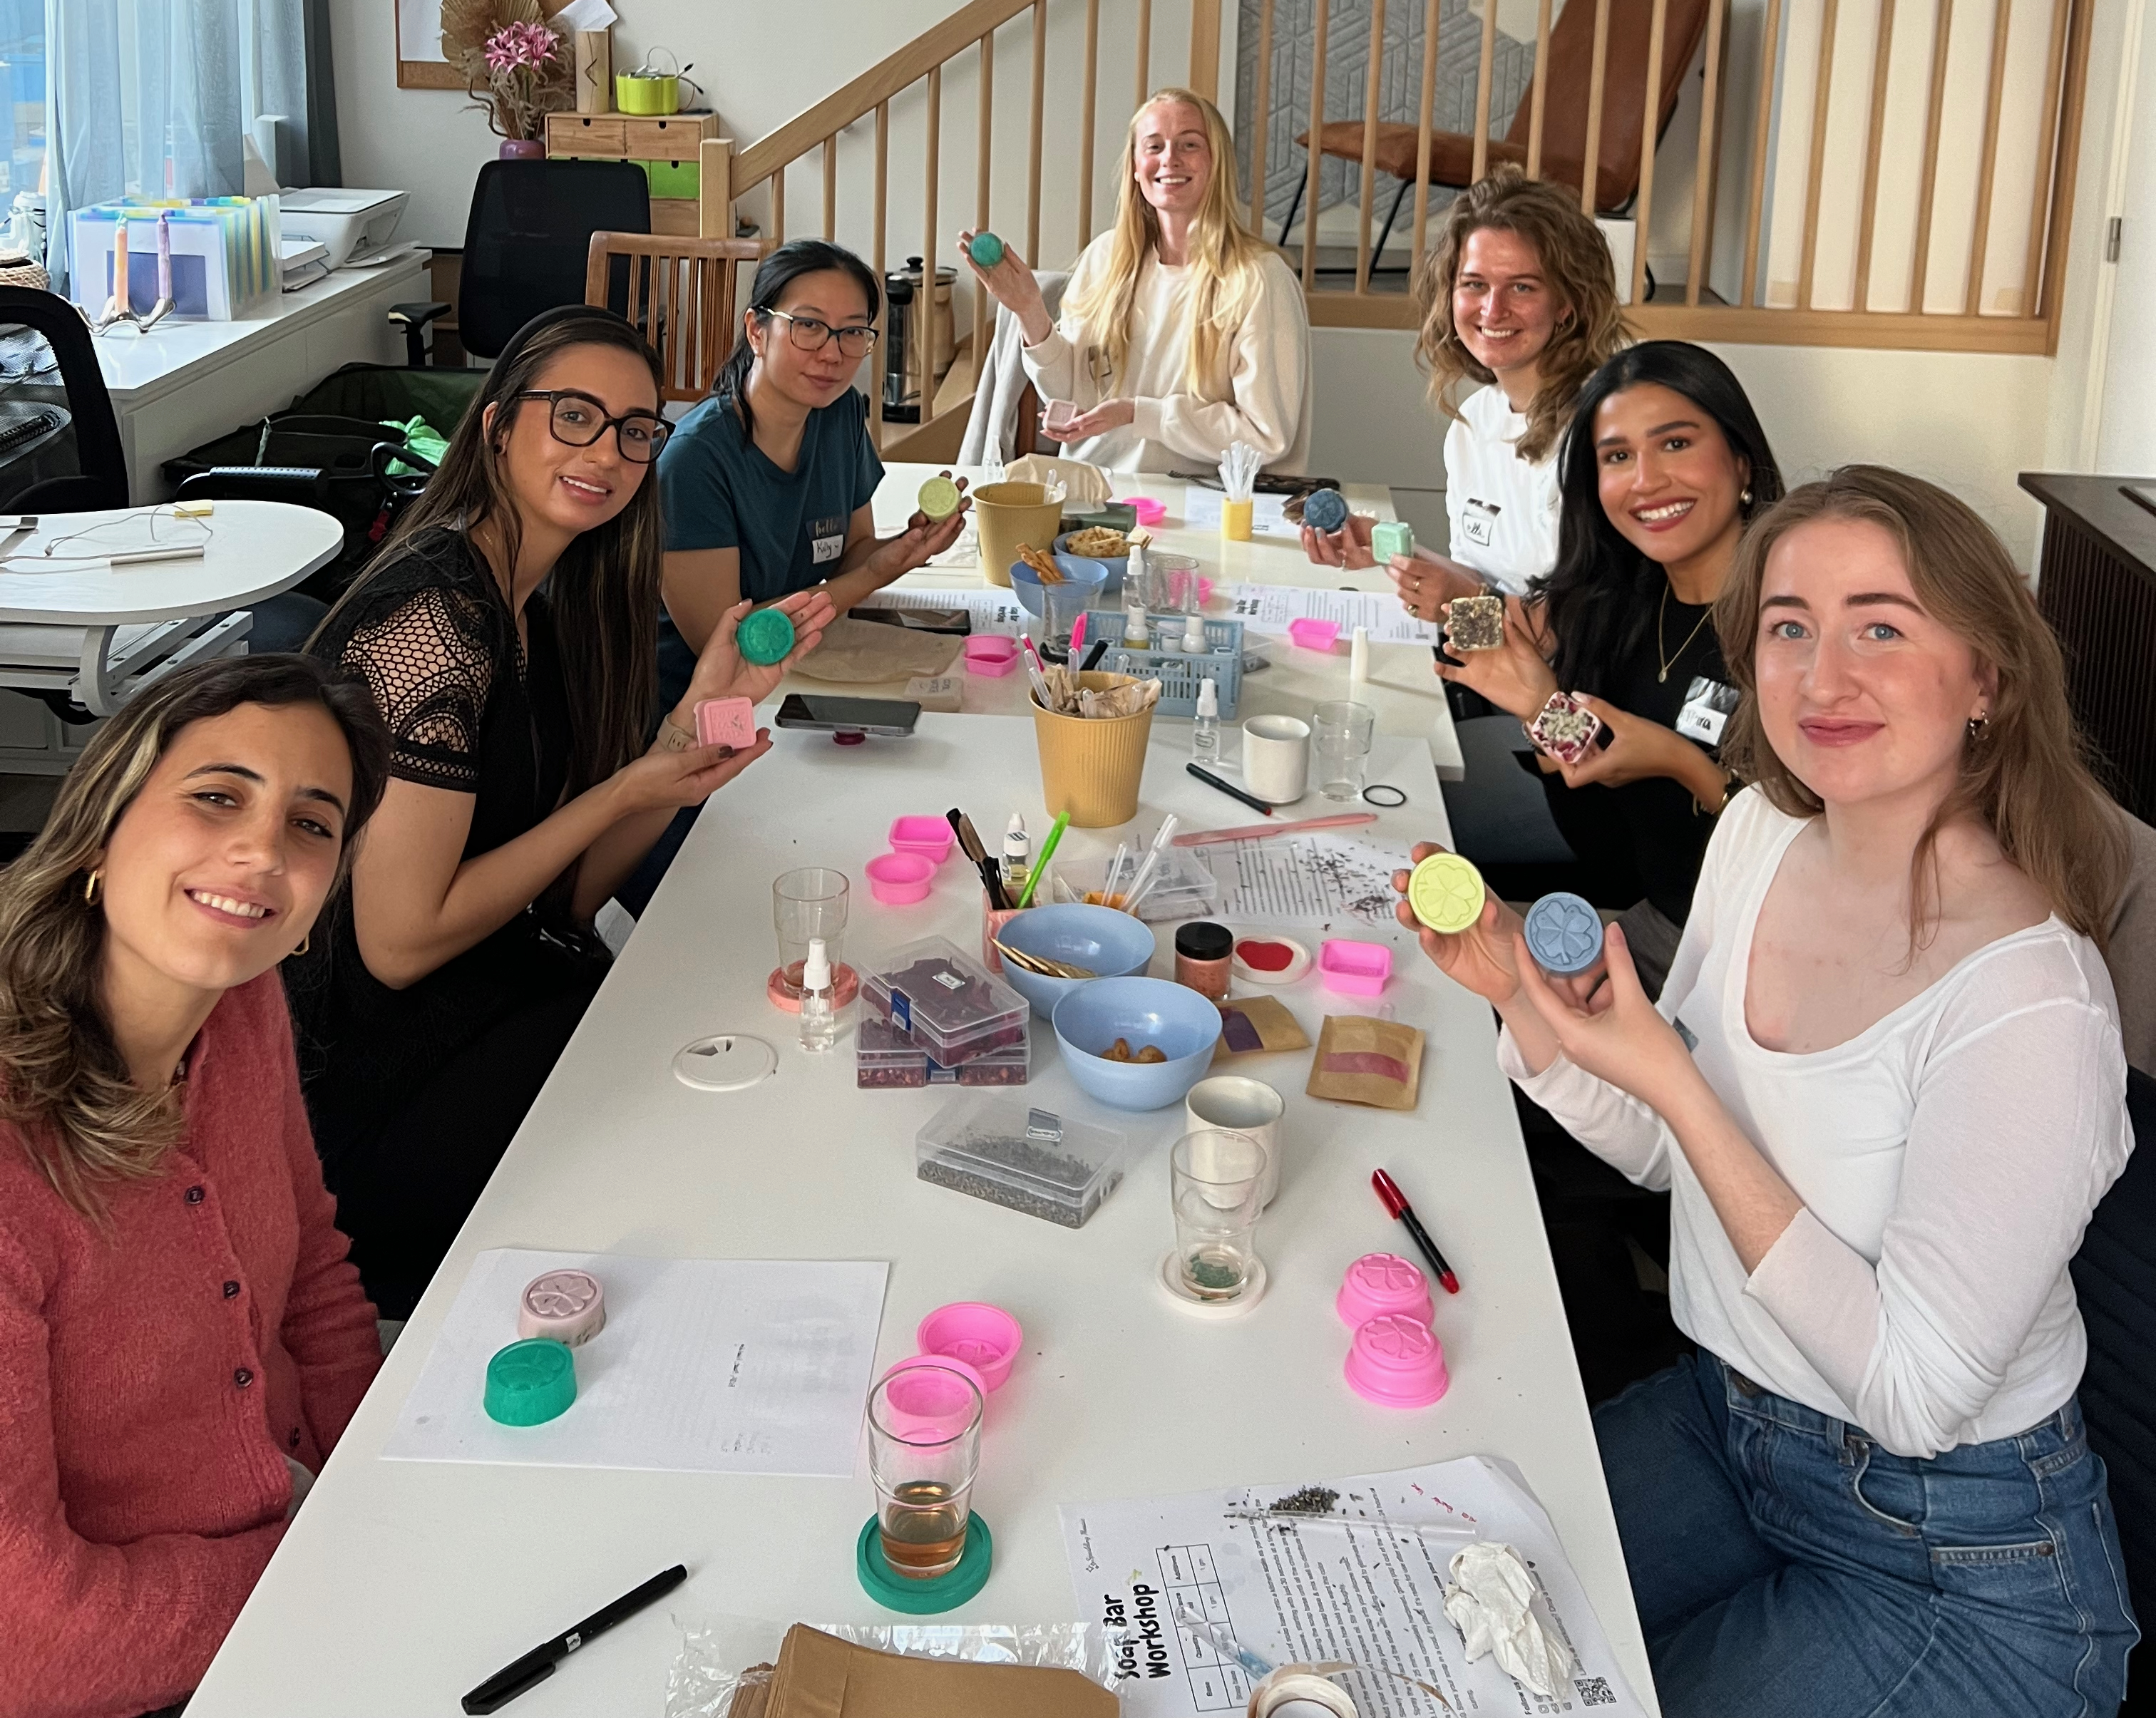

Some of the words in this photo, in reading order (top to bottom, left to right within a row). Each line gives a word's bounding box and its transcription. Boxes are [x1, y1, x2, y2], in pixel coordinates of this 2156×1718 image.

[1102, 1594, 1127, 1627] Bar
[1132, 1583, 1171, 1679] Workshop
[1518, 1692, 1531, 1714] Follow
